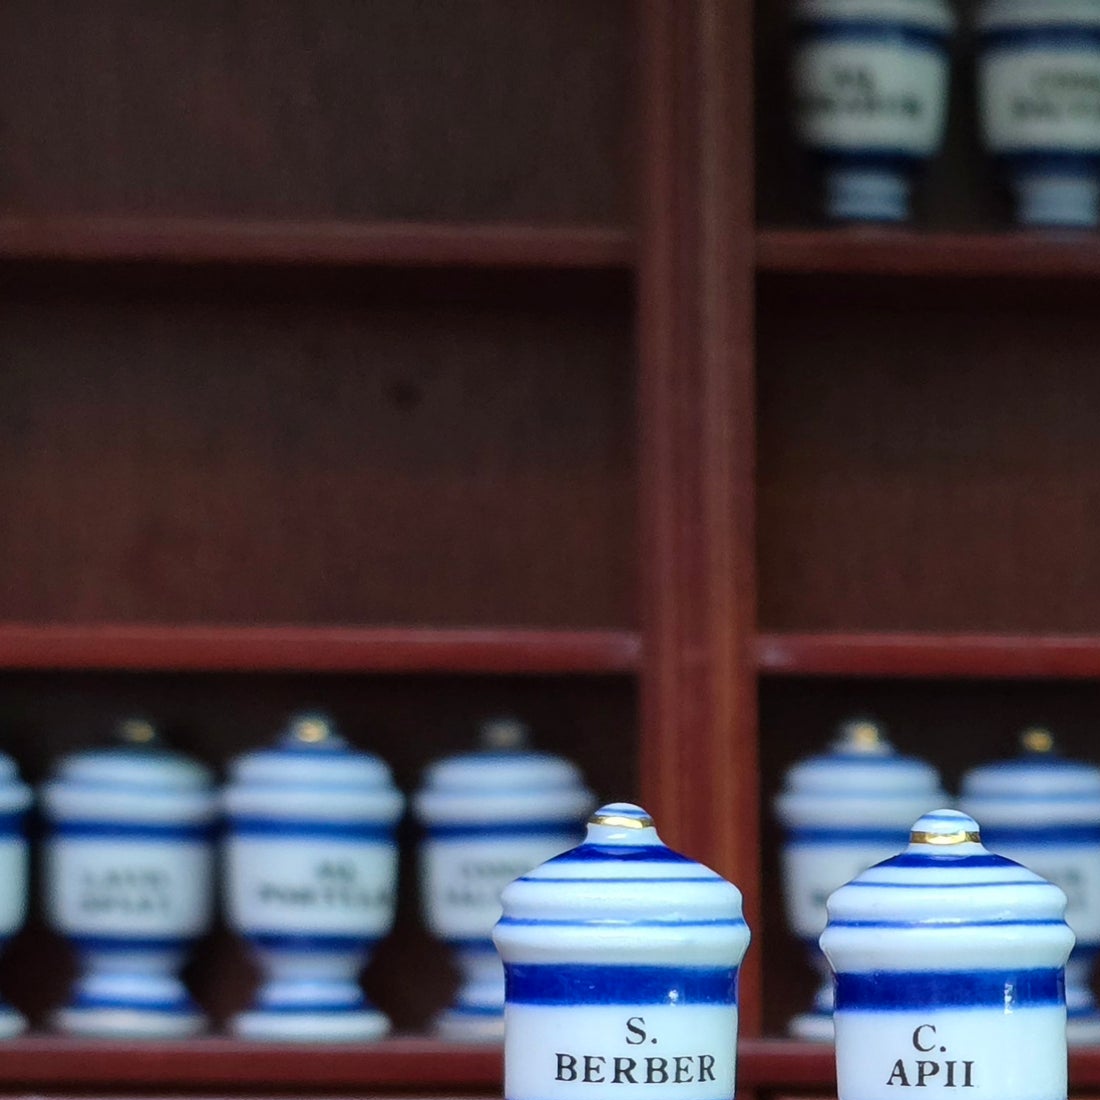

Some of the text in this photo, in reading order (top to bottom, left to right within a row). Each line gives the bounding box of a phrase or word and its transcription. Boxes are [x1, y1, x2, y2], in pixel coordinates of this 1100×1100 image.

[626, 1017, 657, 1045] S.
[912, 1024, 946, 1052] C.
[554, 1053, 716, 1084] BERBER
[886, 1059, 975, 1087] APII
